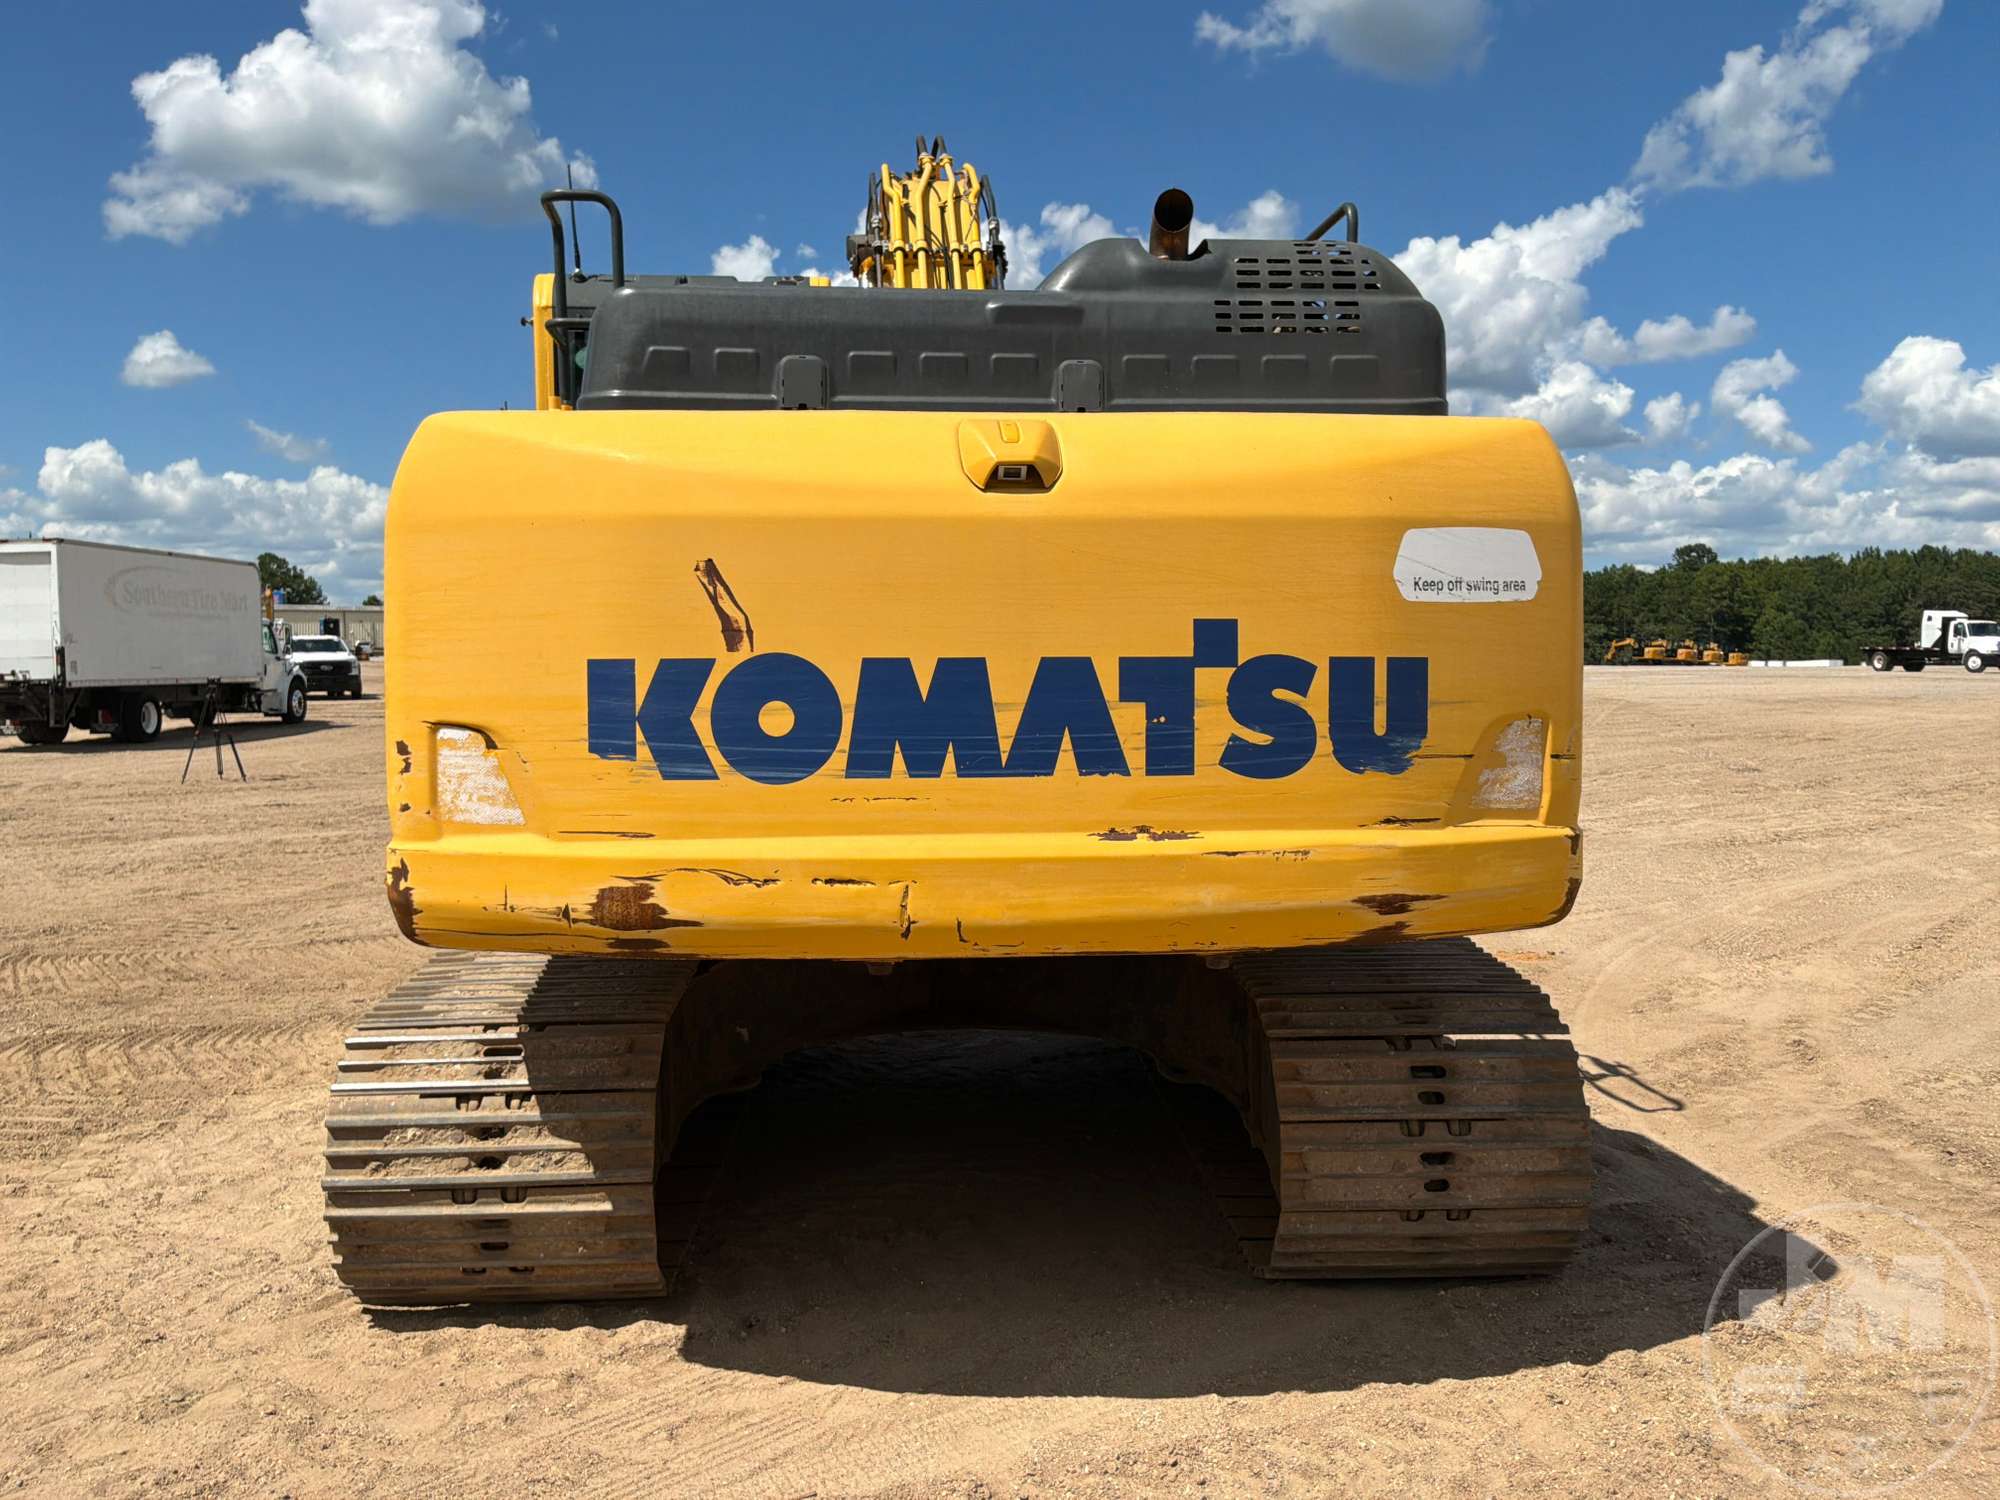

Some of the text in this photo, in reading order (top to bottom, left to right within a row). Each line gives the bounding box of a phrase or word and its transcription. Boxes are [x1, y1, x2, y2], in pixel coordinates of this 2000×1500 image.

[1413, 576, 1527, 595] Keep off swing area
[586, 618, 1429, 784] KOMATSU
